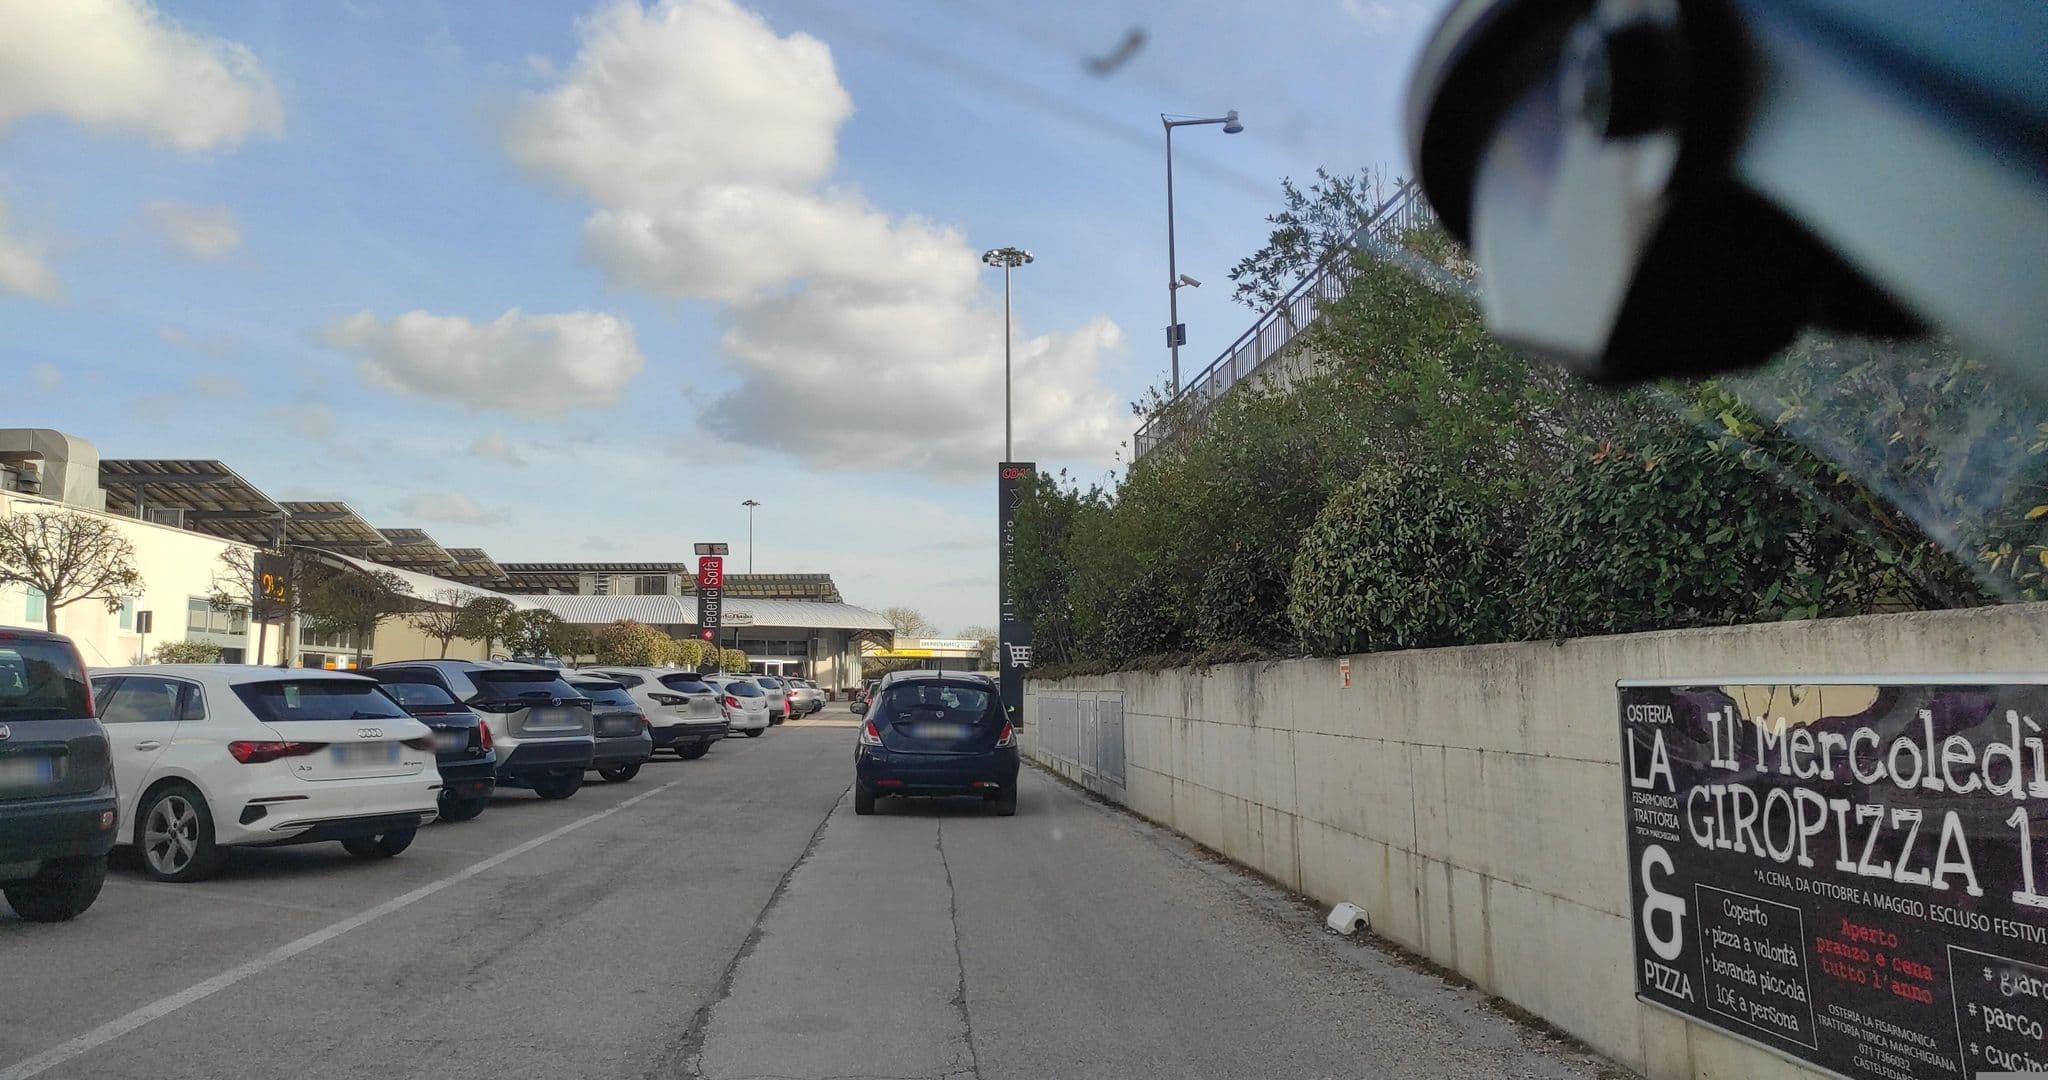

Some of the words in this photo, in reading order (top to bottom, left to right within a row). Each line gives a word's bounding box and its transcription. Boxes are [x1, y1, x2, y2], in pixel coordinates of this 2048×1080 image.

[702, 561, 719, 585] Sofà
[702, 588, 718, 628] Federici
[1627, 704, 1674, 724] OSTERIA
[1627, 728, 1676, 792] LA
[1707, 705, 1739, 772] Il
[1756, 709, 2048, 800] Mercoledì
[1632, 791, 1679, 809] FISARMONICA
[1633, 807, 1680, 830] TRATTORIA
[1687, 783, 1983, 897] GIROPIZZA
[1722, 898, 1768, 927] Coperto
[1766, 871, 1794, 891] CENA,
[1795, 877, 1810, 893] DA
[1812, 880, 1860, 904] OTTOBRE
[1863, 891, 1871, 906] A
[1873, 892, 1927, 920] MAGGIO,
[1930, 904, 1990, 932] ESCLUSO
[1712, 925, 1741, 948] pizza
[1743, 936, 1752, 952] a
[1753, 938, 1799, 967] volontà
[1841, 918, 1898, 949] Aperto
[1816, 936, 1869, 963] pranzo
[1875, 952, 1886, 967] e
[1892, 957, 1933, 981] cena
[1821, 957, 1866, 985] tutto
[1644, 958, 1695, 1003] PIZZA
[1711, 952, 1758, 986] bevanda
[1759, 971, 1807, 1003] piccola
[2000, 971, 2048, 997] giar
[1716, 983, 1738, 1012] 10€
[1739, 996, 1747, 1012] a
[1749, 1000, 1800, 1031] persona
[1982, 1005, 2043, 1040] parco
[1817, 1014, 1860, 1039] TRATTORIA
[1861, 1029, 1888, 1047] TIPICA
[1889, 1040, 1957, 1073] MARCHIGIANA
[1828, 1004, 1861, 1024] OSTERIA
[1862, 1015, 1875, 1028] LA
[1875, 1019, 1937, 1049] FISARMONICA
[1853, 1055, 1919, 1080] CASTELFIDAR
[1859, 1043, 1874, 1057] 071
[1985, 1045, 2048, 1072] cucin
